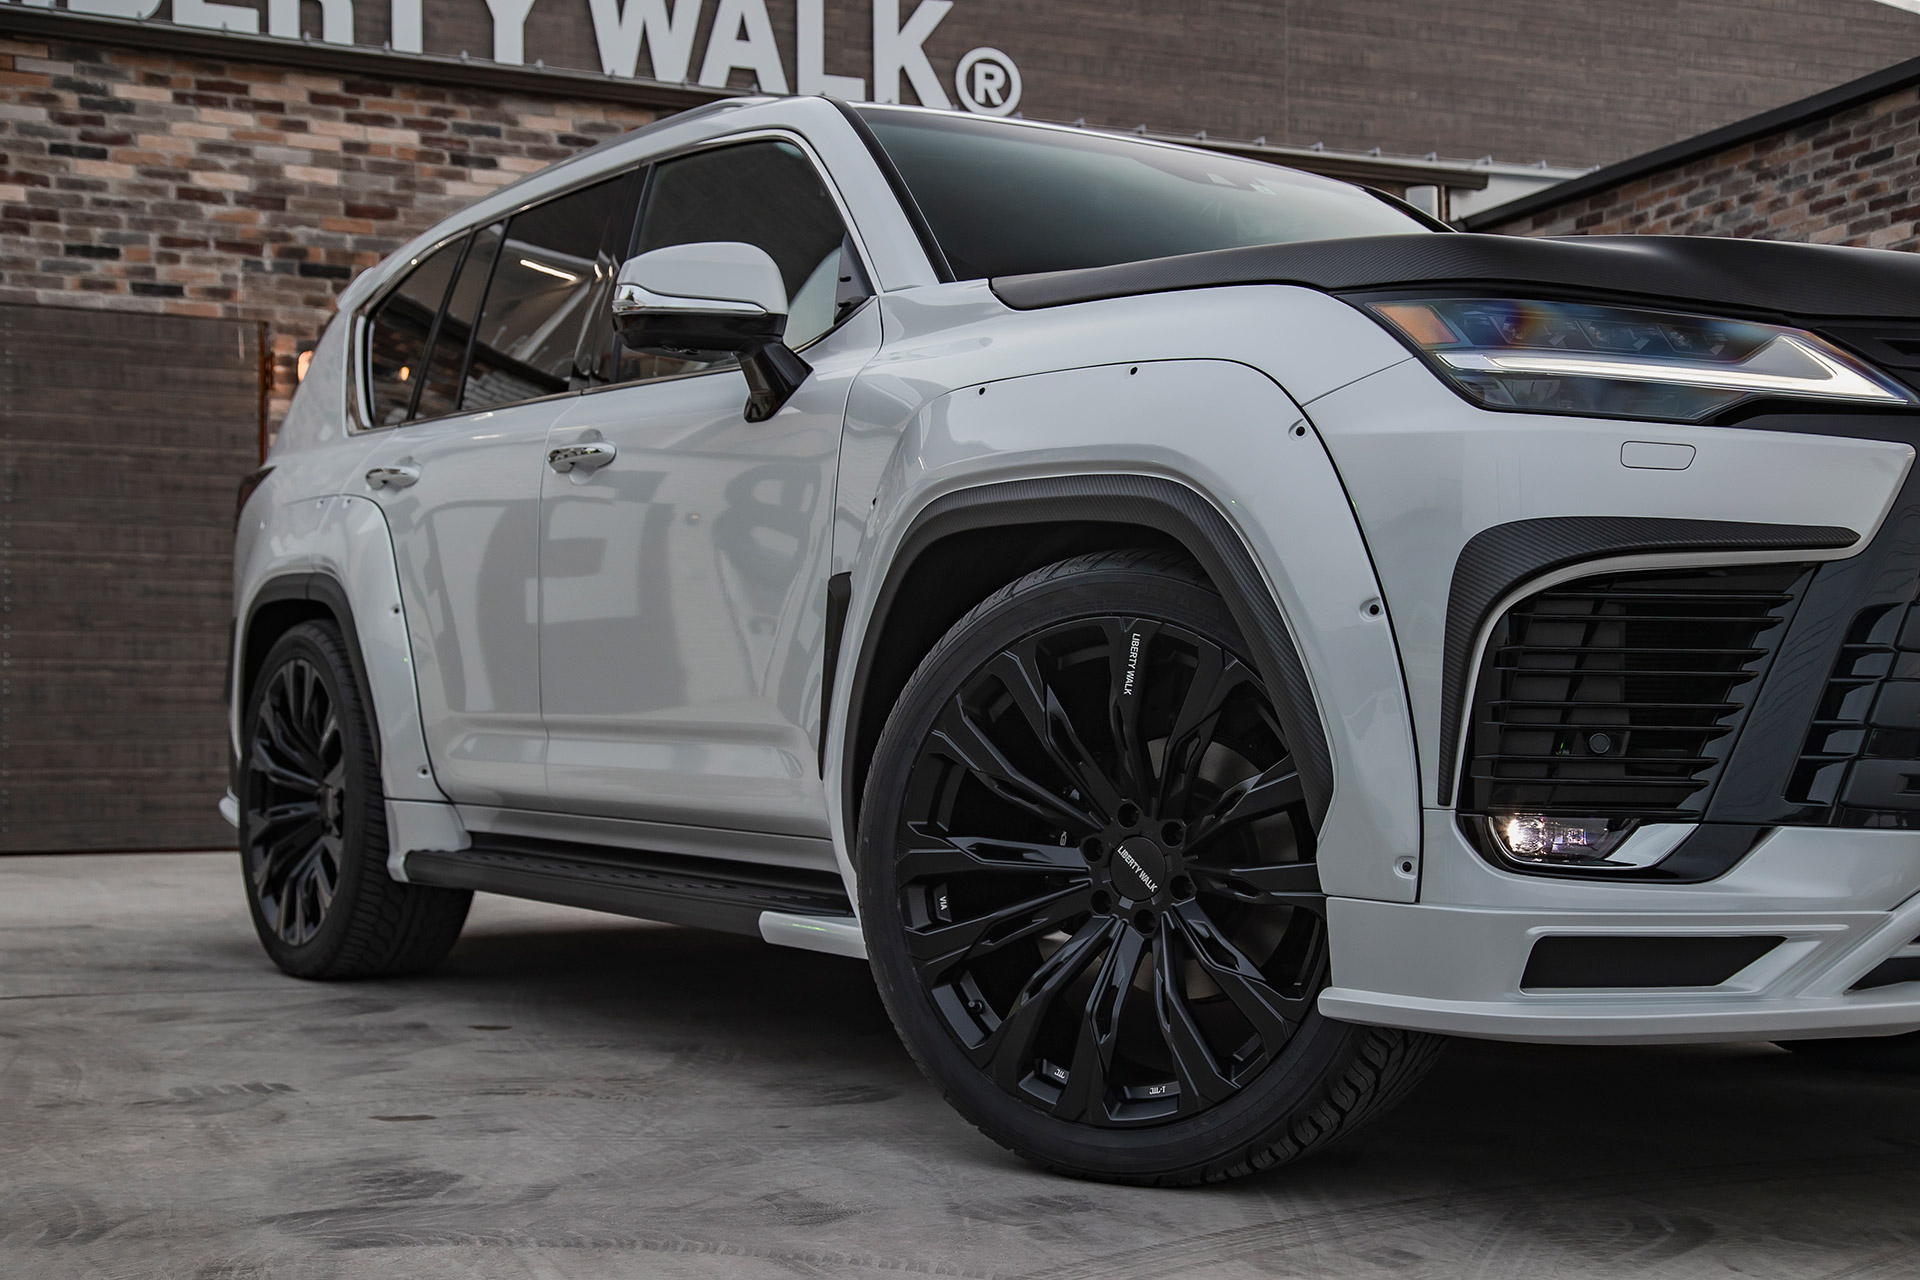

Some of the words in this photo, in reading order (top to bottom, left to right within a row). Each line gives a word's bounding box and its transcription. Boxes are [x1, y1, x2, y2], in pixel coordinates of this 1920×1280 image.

[1128, 632, 1141, 669] LIBERTY
[1123, 670, 1135, 695] WALK
[1117, 845, 1142, 873] LIBERTY
[1138, 869, 1158, 893] WALK
